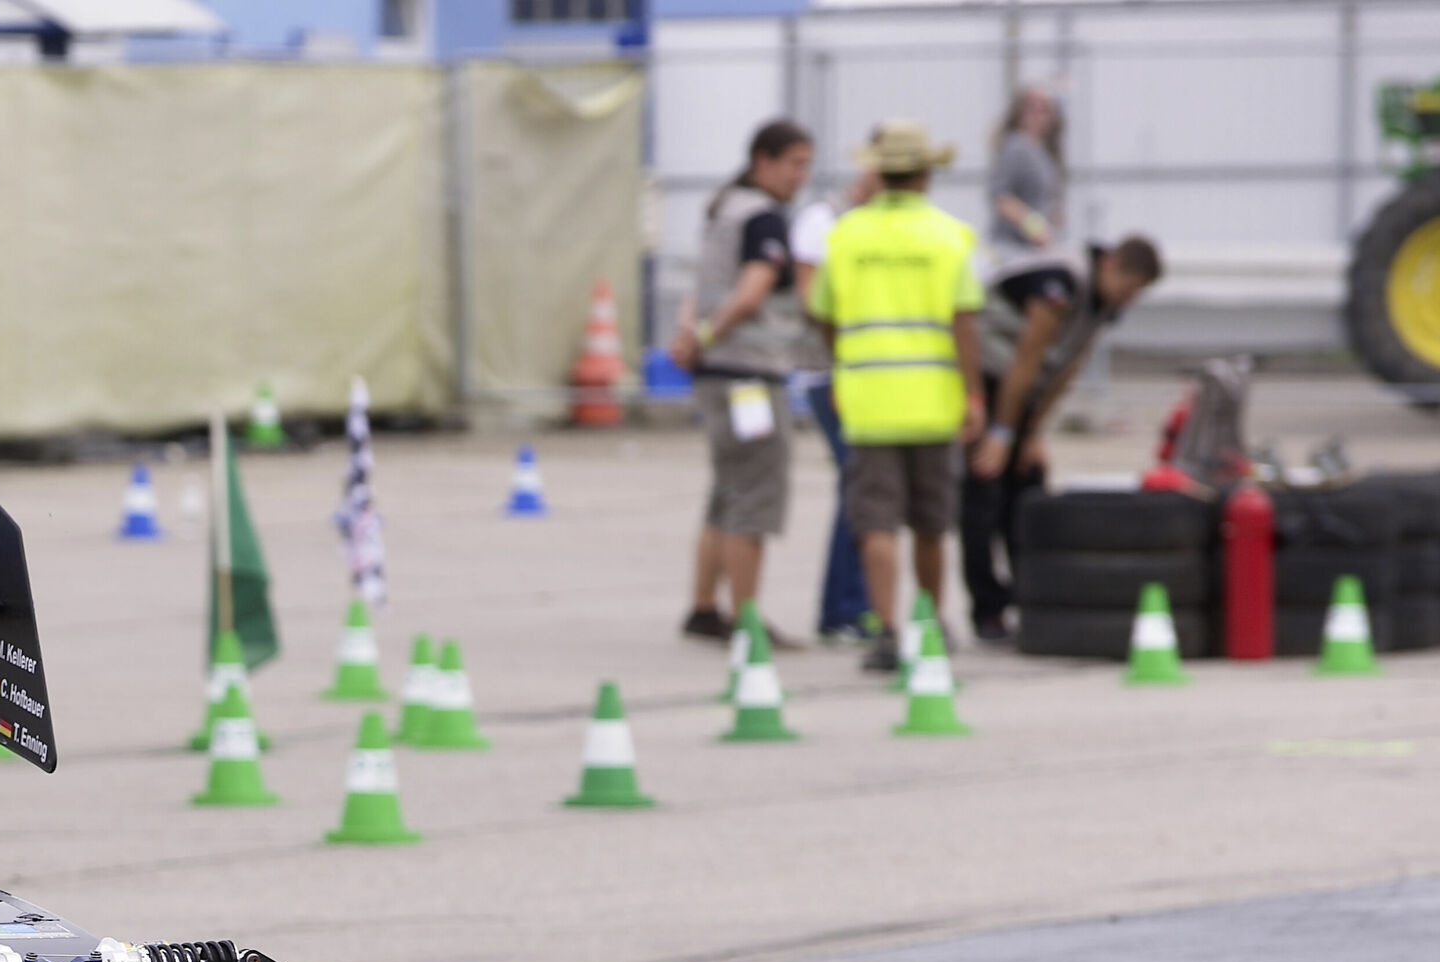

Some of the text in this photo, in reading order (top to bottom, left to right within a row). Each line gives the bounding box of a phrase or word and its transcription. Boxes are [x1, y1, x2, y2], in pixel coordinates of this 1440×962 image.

[7, 645, 37, 674] Kellerer
[0, 680, 9, 699] C.
[13, 722, 21, 742] T.
